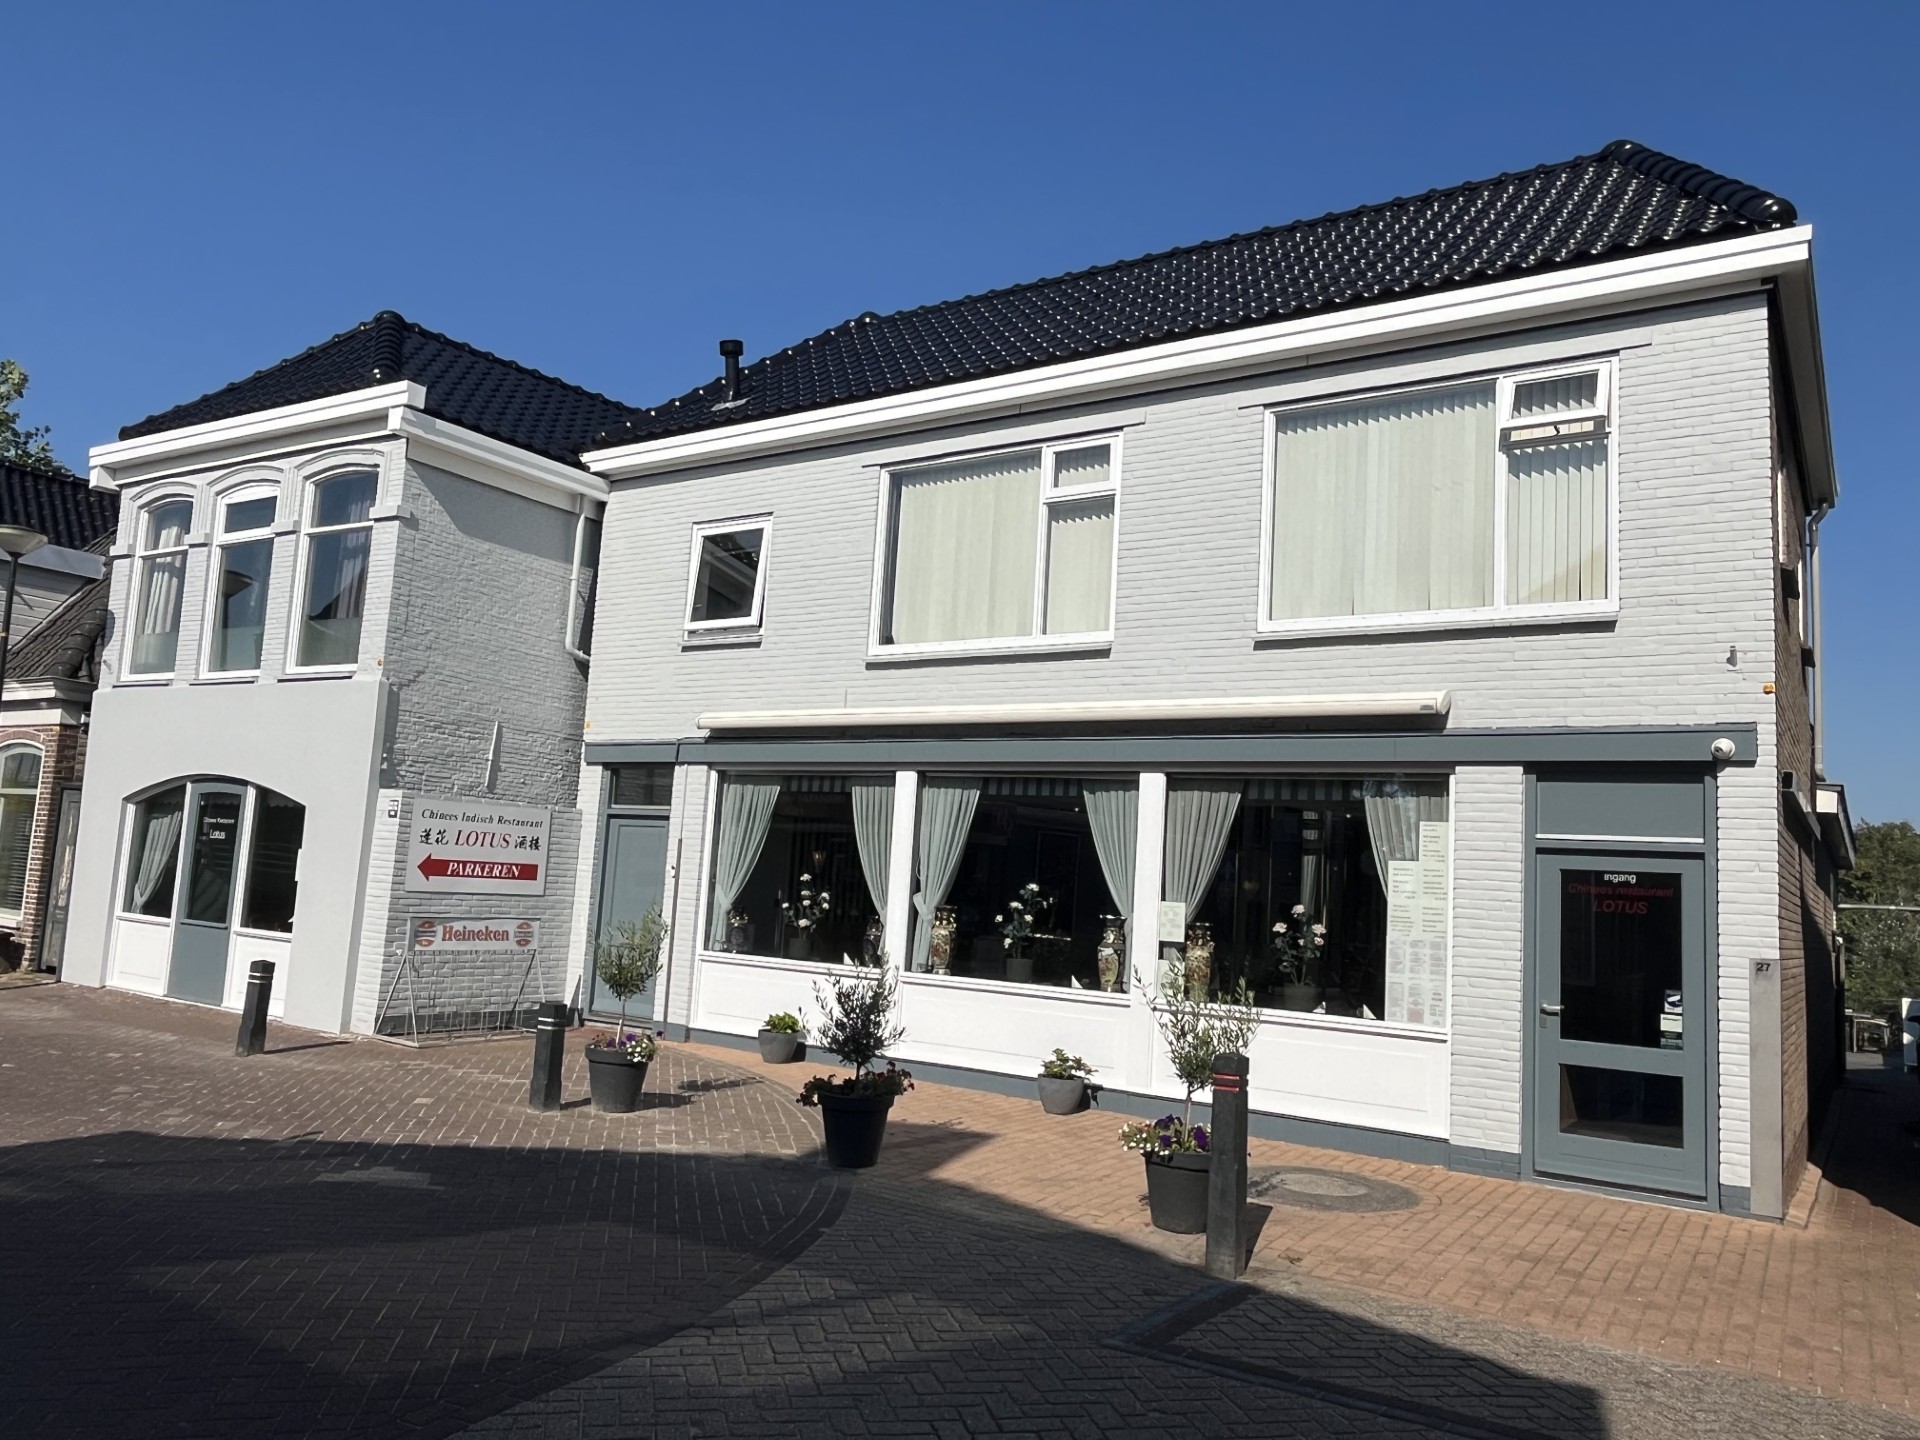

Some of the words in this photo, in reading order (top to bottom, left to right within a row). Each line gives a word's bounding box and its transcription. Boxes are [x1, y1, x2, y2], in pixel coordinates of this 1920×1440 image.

[421, 808, 459, 822] Chinees
[461, 812, 494, 825] Indisch
[497, 815, 543, 829] Restaurant
[454, 829, 512, 849] LOTUS
[446, 861, 521, 878] PARKEREN
[1593, 900, 1649, 914] LOTUS
[441, 925, 510, 942] Heineken
[1756, 962, 1771, 972] 27
